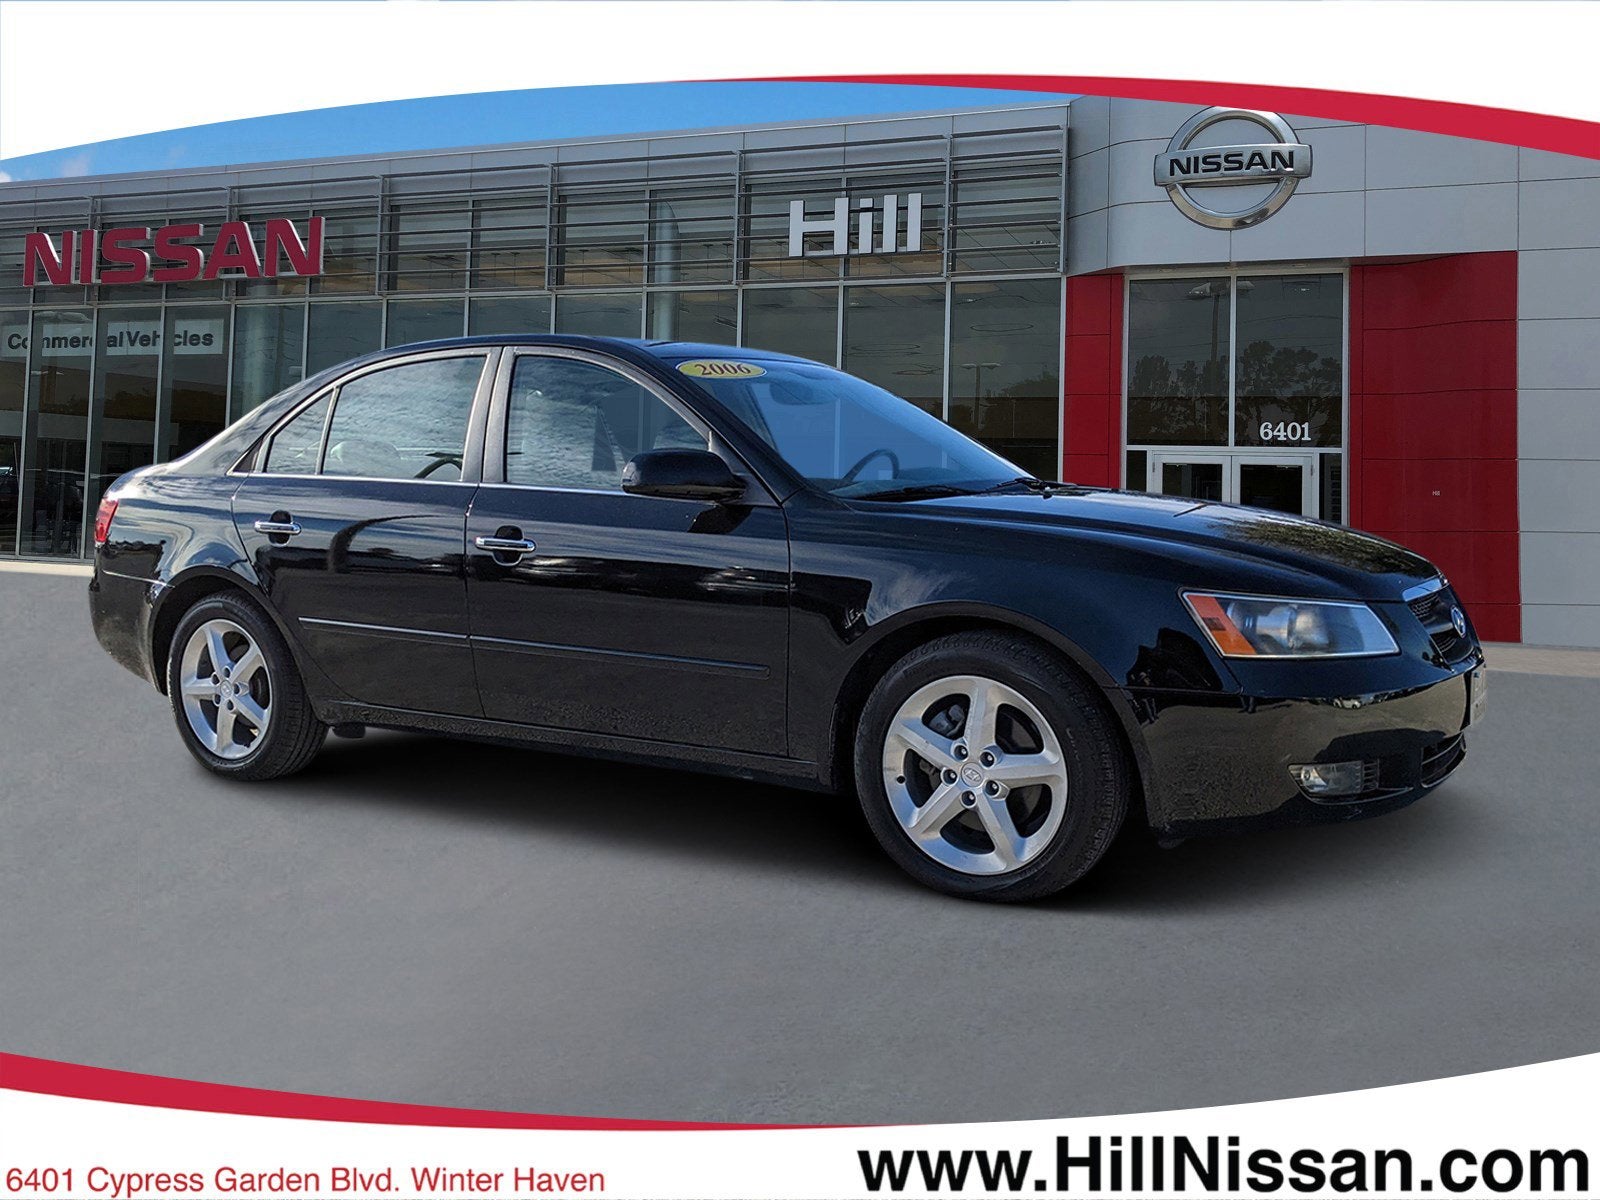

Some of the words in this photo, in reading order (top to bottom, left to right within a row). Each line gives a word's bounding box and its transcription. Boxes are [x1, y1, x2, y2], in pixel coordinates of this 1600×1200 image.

[1169, 150, 1295, 177] NISSAN
[788, 192, 922, 257] Hill
[23, 216, 325, 287] NISSAN
[7, 331, 123, 350] Comeral
[126, 329, 214, 347] Vehcles
[694, 363, 752, 376] 2006
[1259, 421, 1312, 442] 6401
